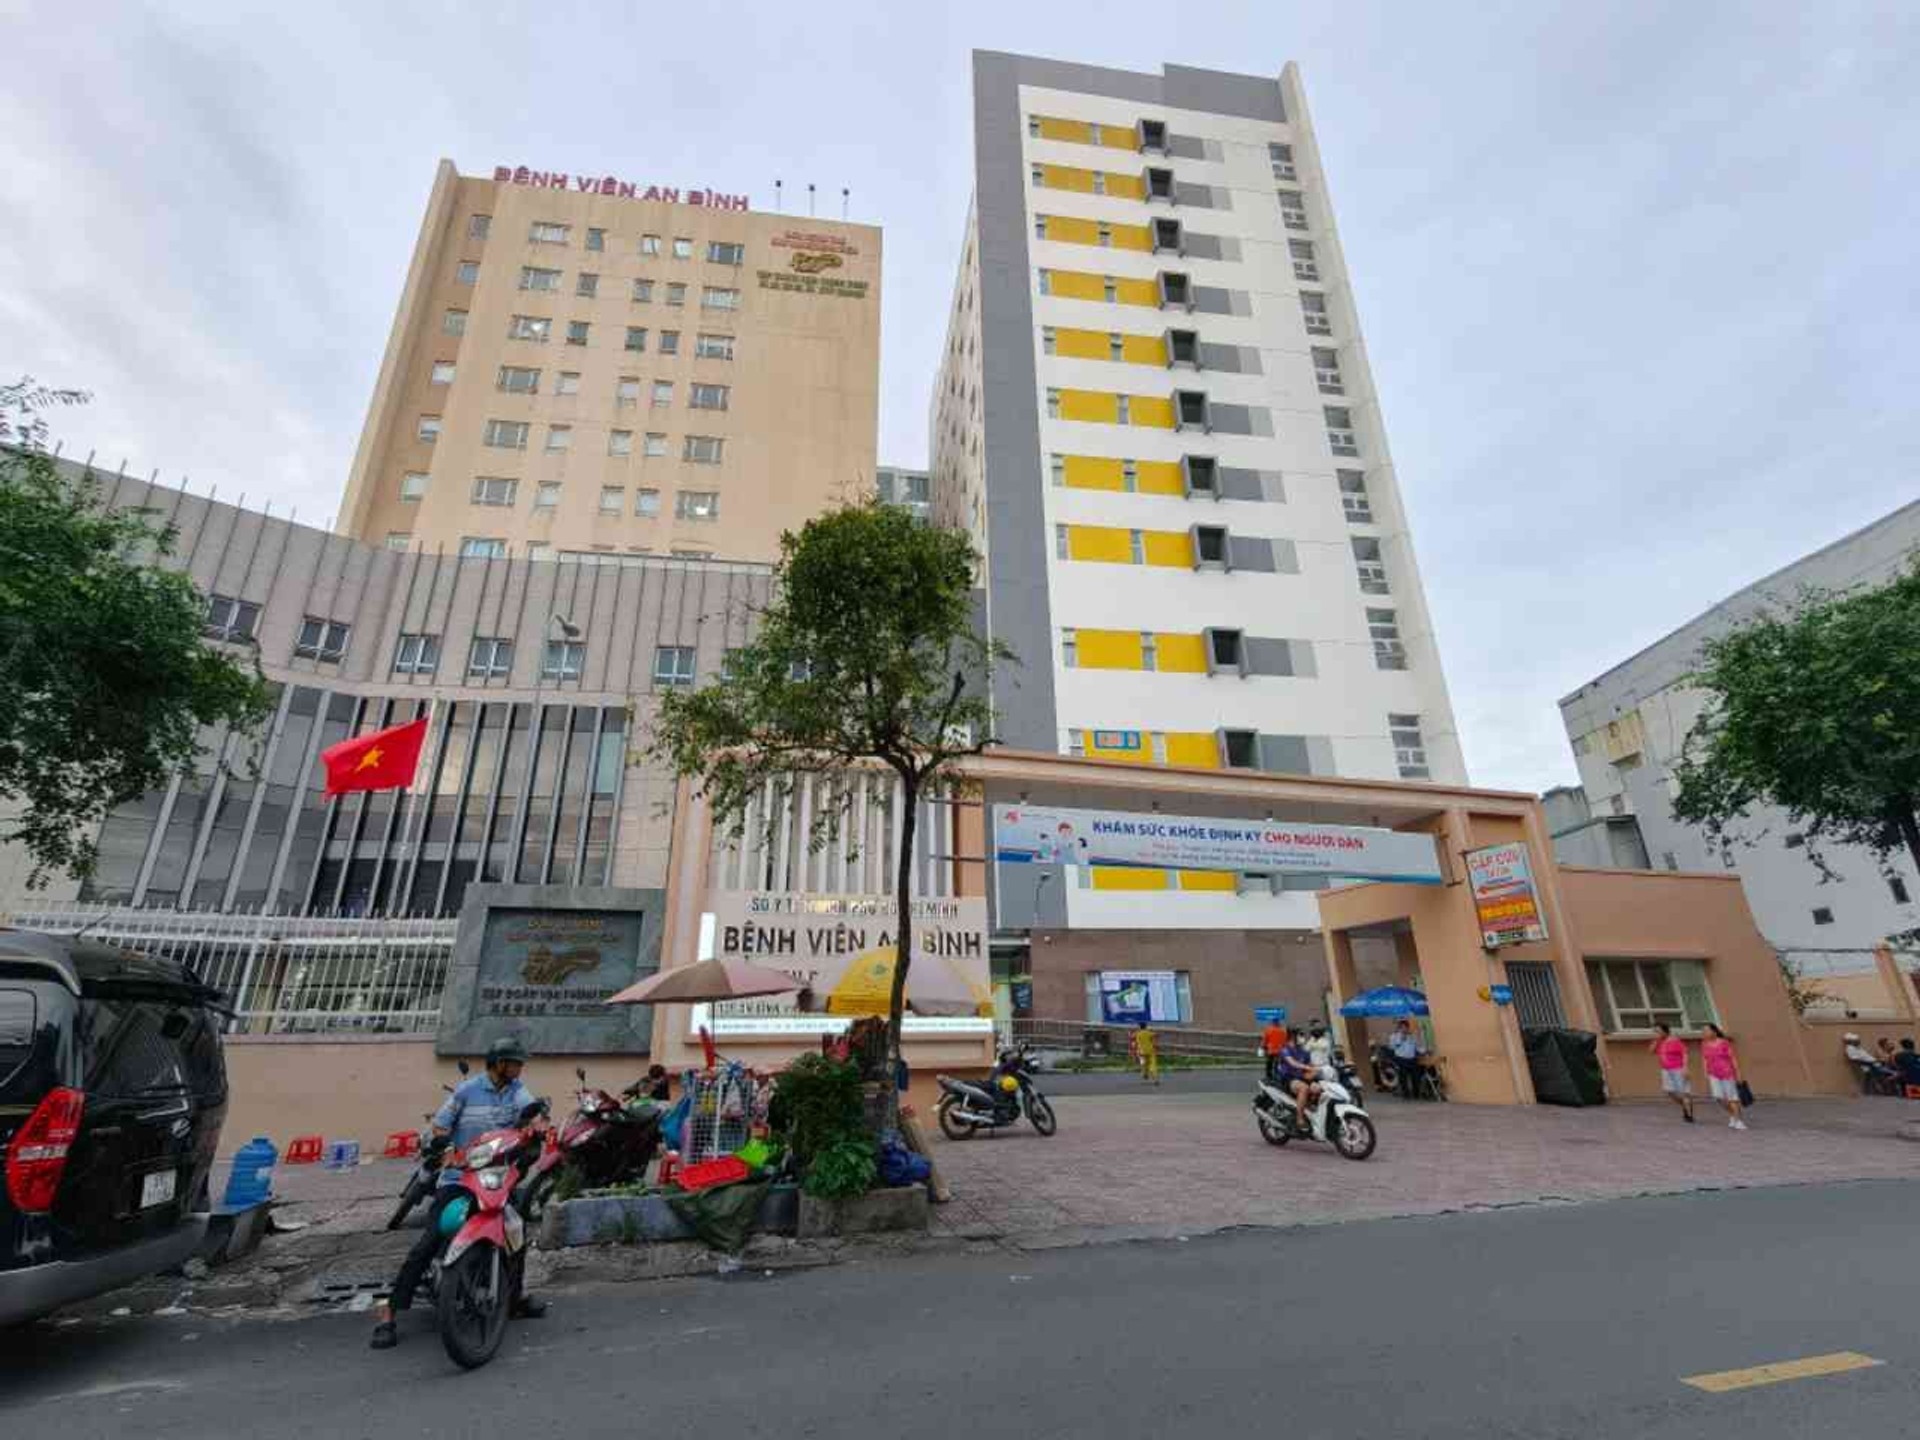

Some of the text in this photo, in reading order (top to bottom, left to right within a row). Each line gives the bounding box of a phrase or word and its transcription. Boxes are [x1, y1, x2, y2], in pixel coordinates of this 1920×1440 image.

[642, 185, 679, 203] AN
[1264, 830, 1292, 844] CHO
[922, 924, 982, 956] BÌNH
